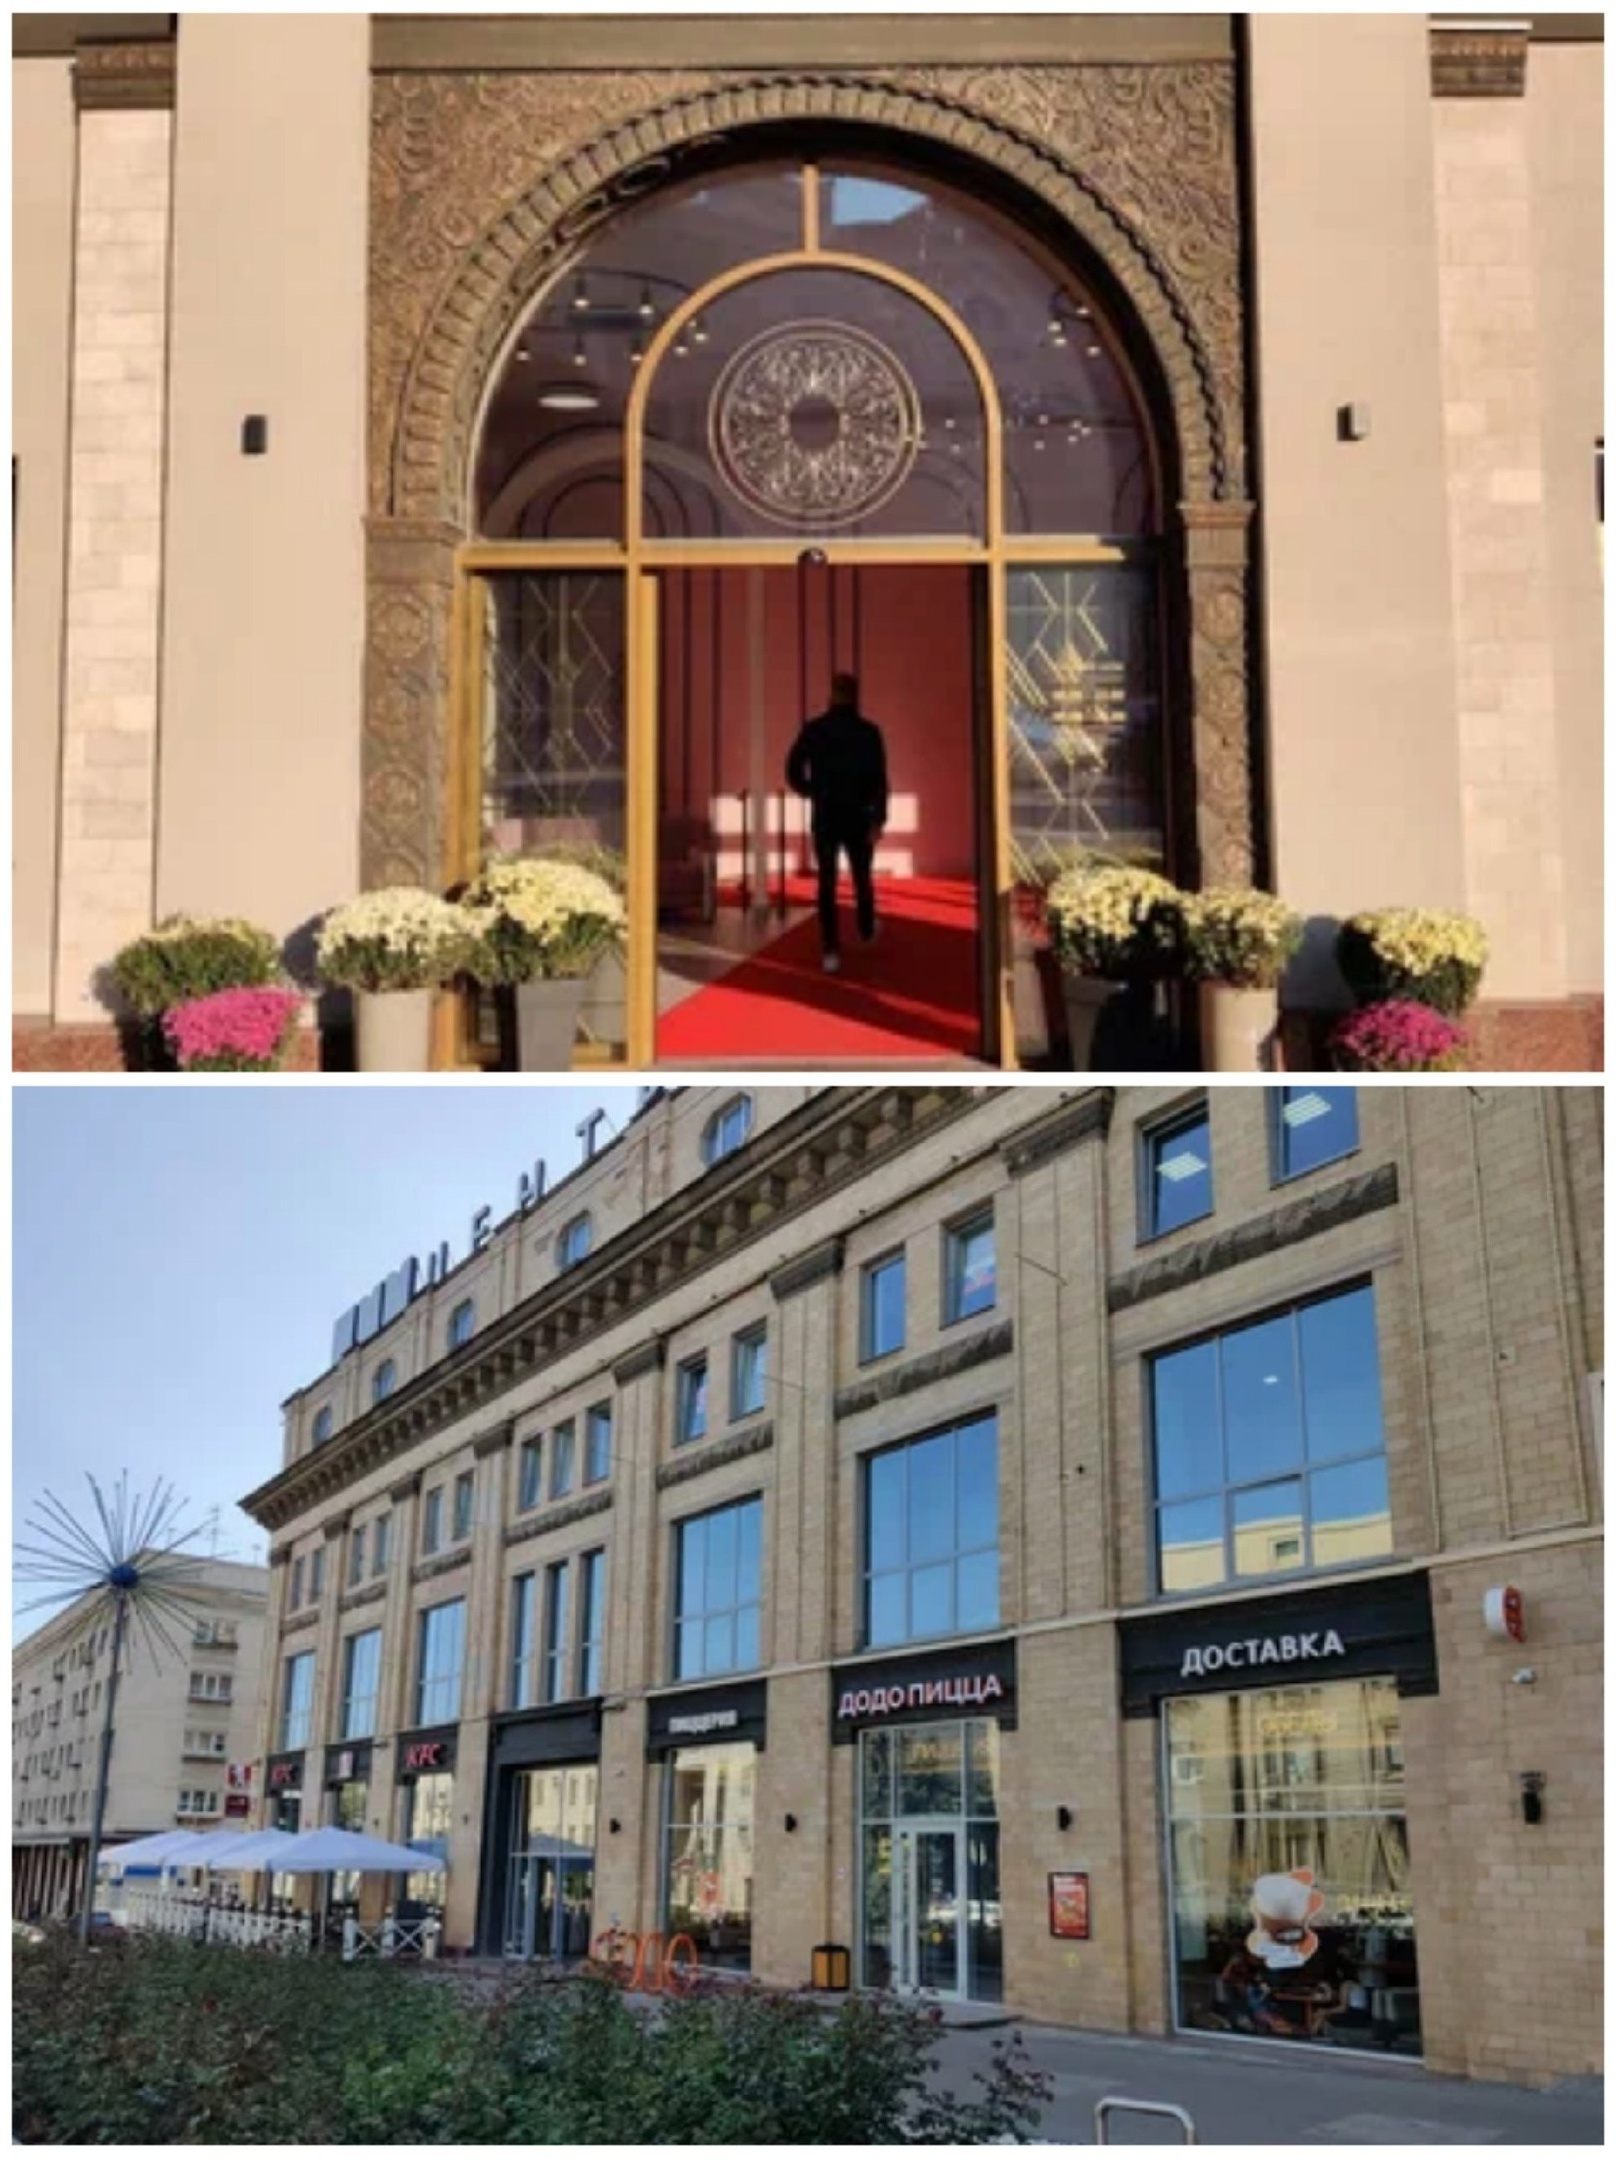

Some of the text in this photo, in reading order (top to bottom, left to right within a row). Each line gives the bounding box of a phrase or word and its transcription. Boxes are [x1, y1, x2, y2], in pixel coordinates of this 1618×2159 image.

[1180, 1628, 1346, 1678] ДОСТАВКА
[838, 1673, 1003, 1719] ДОДО ПИЦЦА
[405, 1743, 441, 1768] KFC
